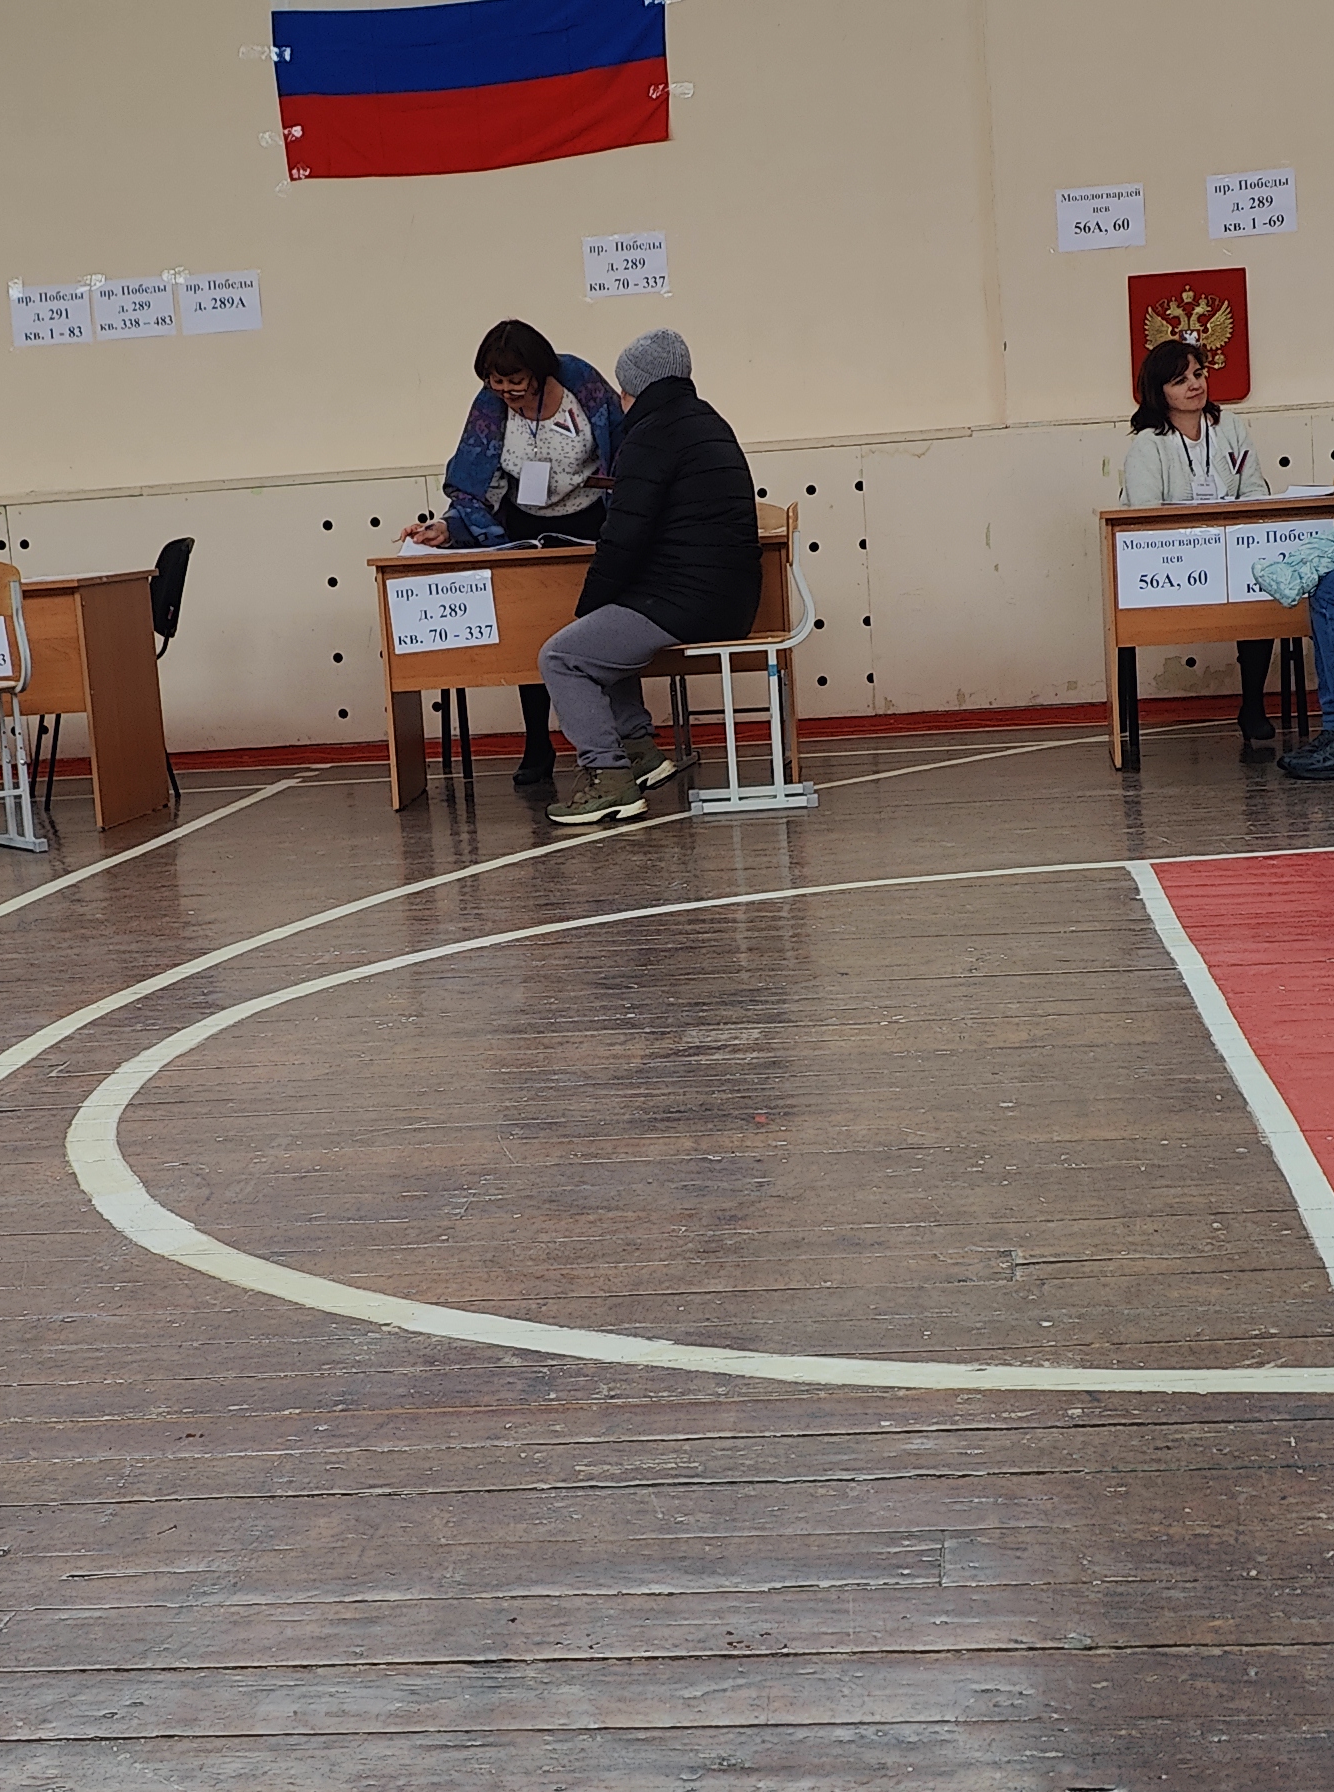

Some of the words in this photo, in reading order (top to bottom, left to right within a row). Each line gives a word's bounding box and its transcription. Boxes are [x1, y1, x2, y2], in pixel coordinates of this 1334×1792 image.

[1214, 184, 1234, 195] пр.
[1238, 177, 1289, 191] Победы
[1060, 188, 1141, 203] Молодогвардей
[1231, 202, 1244, 213] д.
[1248, 195, 1274, 209] 289
[1092, 205, 1111, 214] цев
[1113, 217, 1130, 232] 60
[1223, 222, 1246, 233] кв.
[589, 244, 608, 256] пр.
[615, 240, 662, 252] Победы
[607, 262, 619, 273] д.
[623, 257, 646, 271] 289
[99, 288, 119, 300] пр.
[121, 283, 167, 296] Победы
[185, 282, 205, 294] пр.
[208, 277, 254, 290] Победы
[589, 282, 610, 292] кв.
[614, 278, 630, 291] 70
[642, 275, 666, 289] 337
[17, 295, 36, 306] пр.
[39, 291, 84, 303] Победы
[118, 303, 129, 314] д.
[131, 300, 151, 313] 289
[194, 299, 208, 312] д.
[211, 295, 246, 310] 289А
[33, 312, 45, 323] д.
[48, 308, 70, 321] 291
[100, 322, 118, 332] кв.
[120, 317, 141, 330] 338
[153, 314, 174, 327] 483
[24, 332, 45, 342] кв.
[49, 328, 54, 340] 1
[68, 325, 83, 339] 83
[1122, 533, 1221, 551] Молодогвардей
[1236, 534, 1260, 547] пр.
[1161, 554, 1184, 564] цев
[1187, 569, 1208, 587] 60
[395, 588, 419, 601] пр.
[428, 581, 487, 596] Победы
[418, 609, 434, 622] д.
[438, 602, 467, 619] 289
[398, 635, 424, 646] кв.
[428, 628, 448, 643] 70
[464, 624, 494, 641] 337
